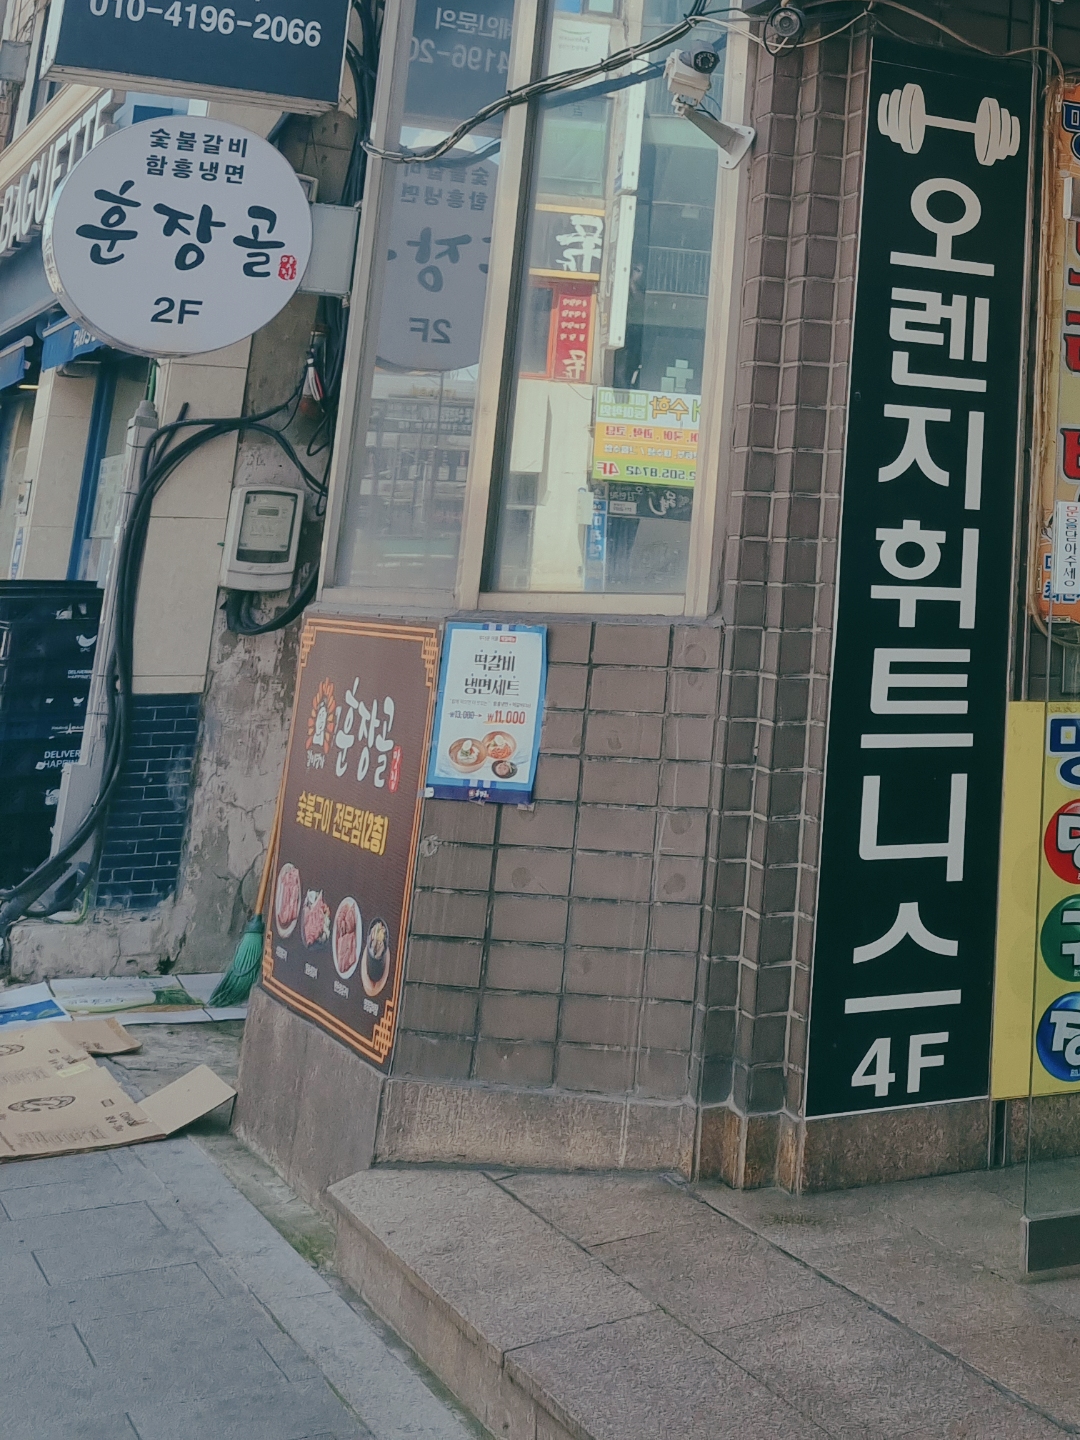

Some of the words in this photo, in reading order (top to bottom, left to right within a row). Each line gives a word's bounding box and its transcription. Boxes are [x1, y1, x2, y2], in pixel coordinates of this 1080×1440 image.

[150, 127, 249, 158] 숯불갈비
[146, 154, 245, 184] 함흥냉면
[76, 180, 285, 278] 훈장골
[151, 297, 203, 325] 2F
[844, 177, 995, 1015] 오렌지휘트니스
[464, 678, 520, 697] 냉면세트
[474, 654, 516, 673] 떡갈비
[335, 677, 395, 788] 훈장골
[296, 789, 331, 837] 숯불구이
[332, 800, 390, 856] 전문점(2층)
[851, 1031, 949, 1099] 4F
